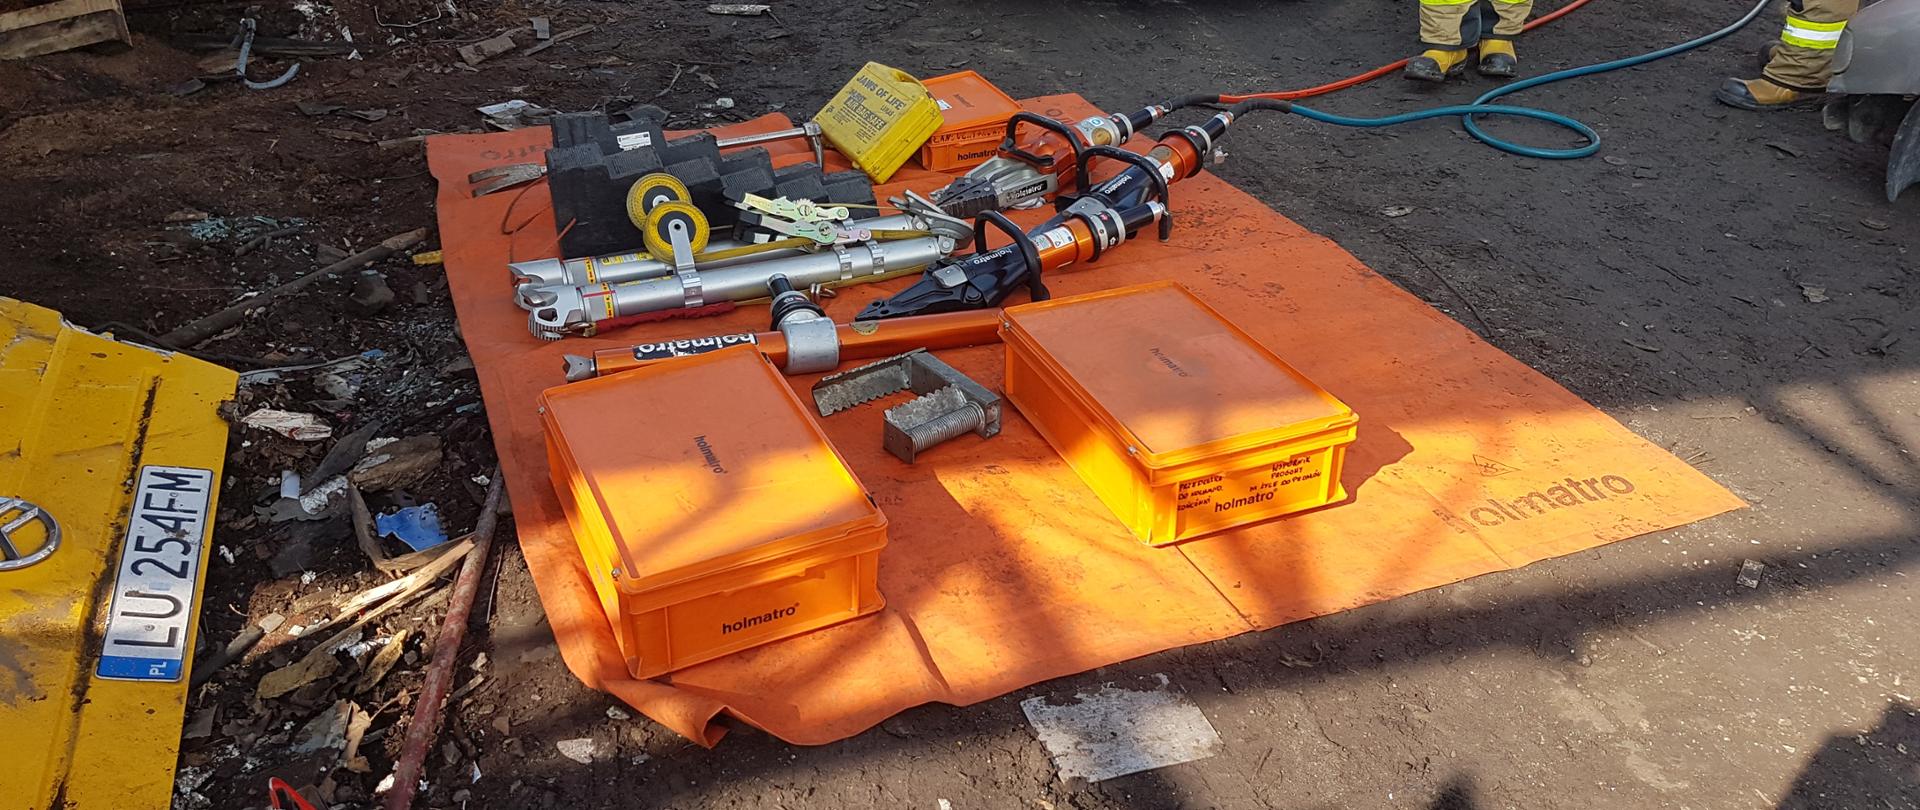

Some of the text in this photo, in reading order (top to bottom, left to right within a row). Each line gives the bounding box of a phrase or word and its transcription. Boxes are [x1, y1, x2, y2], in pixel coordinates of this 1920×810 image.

[857, 75, 905, 111] JAWS OF LIFE
[974, 248, 1012, 265] holmatro
[640, 332, 756, 355] holmatro
[114, 471, 203, 648] LU 254FM
[149, 661, 167, 676] PL
